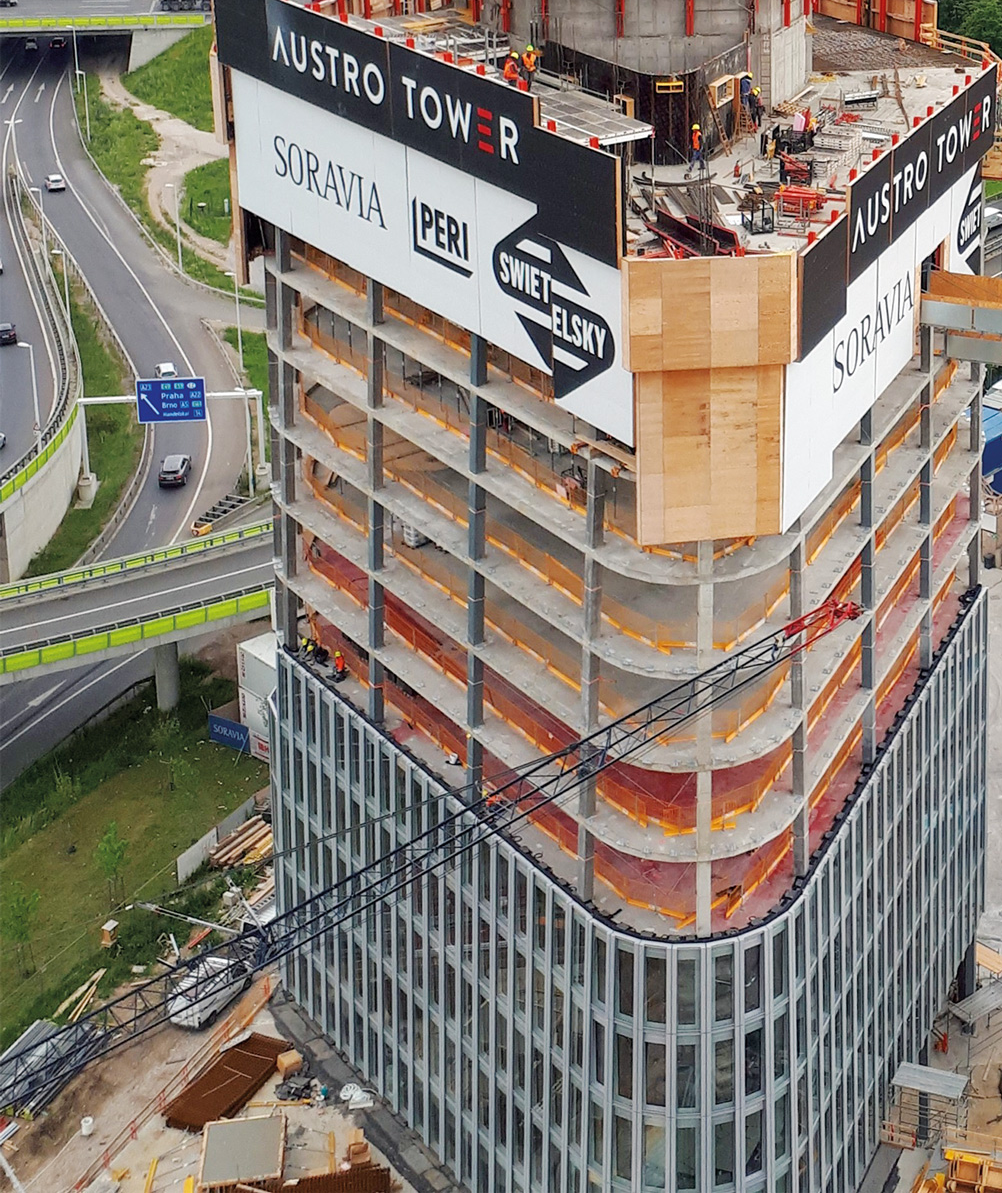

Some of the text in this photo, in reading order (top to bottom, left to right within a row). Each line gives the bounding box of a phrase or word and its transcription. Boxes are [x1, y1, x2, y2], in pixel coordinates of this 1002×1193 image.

[272, 25, 519, 165] AUSTRO TOWER
[273, 135, 389, 231] SORAVIA
[852, 94, 991, 253] AUSTRO TOWER
[421, 202, 470, 262] PERI
[499, 251, 552, 304] SWIET
[552, 303, 607, 359] ELSKY
[832, 269, 914, 394] SORAVIA
[212, 724, 246, 743] SORAVIA
